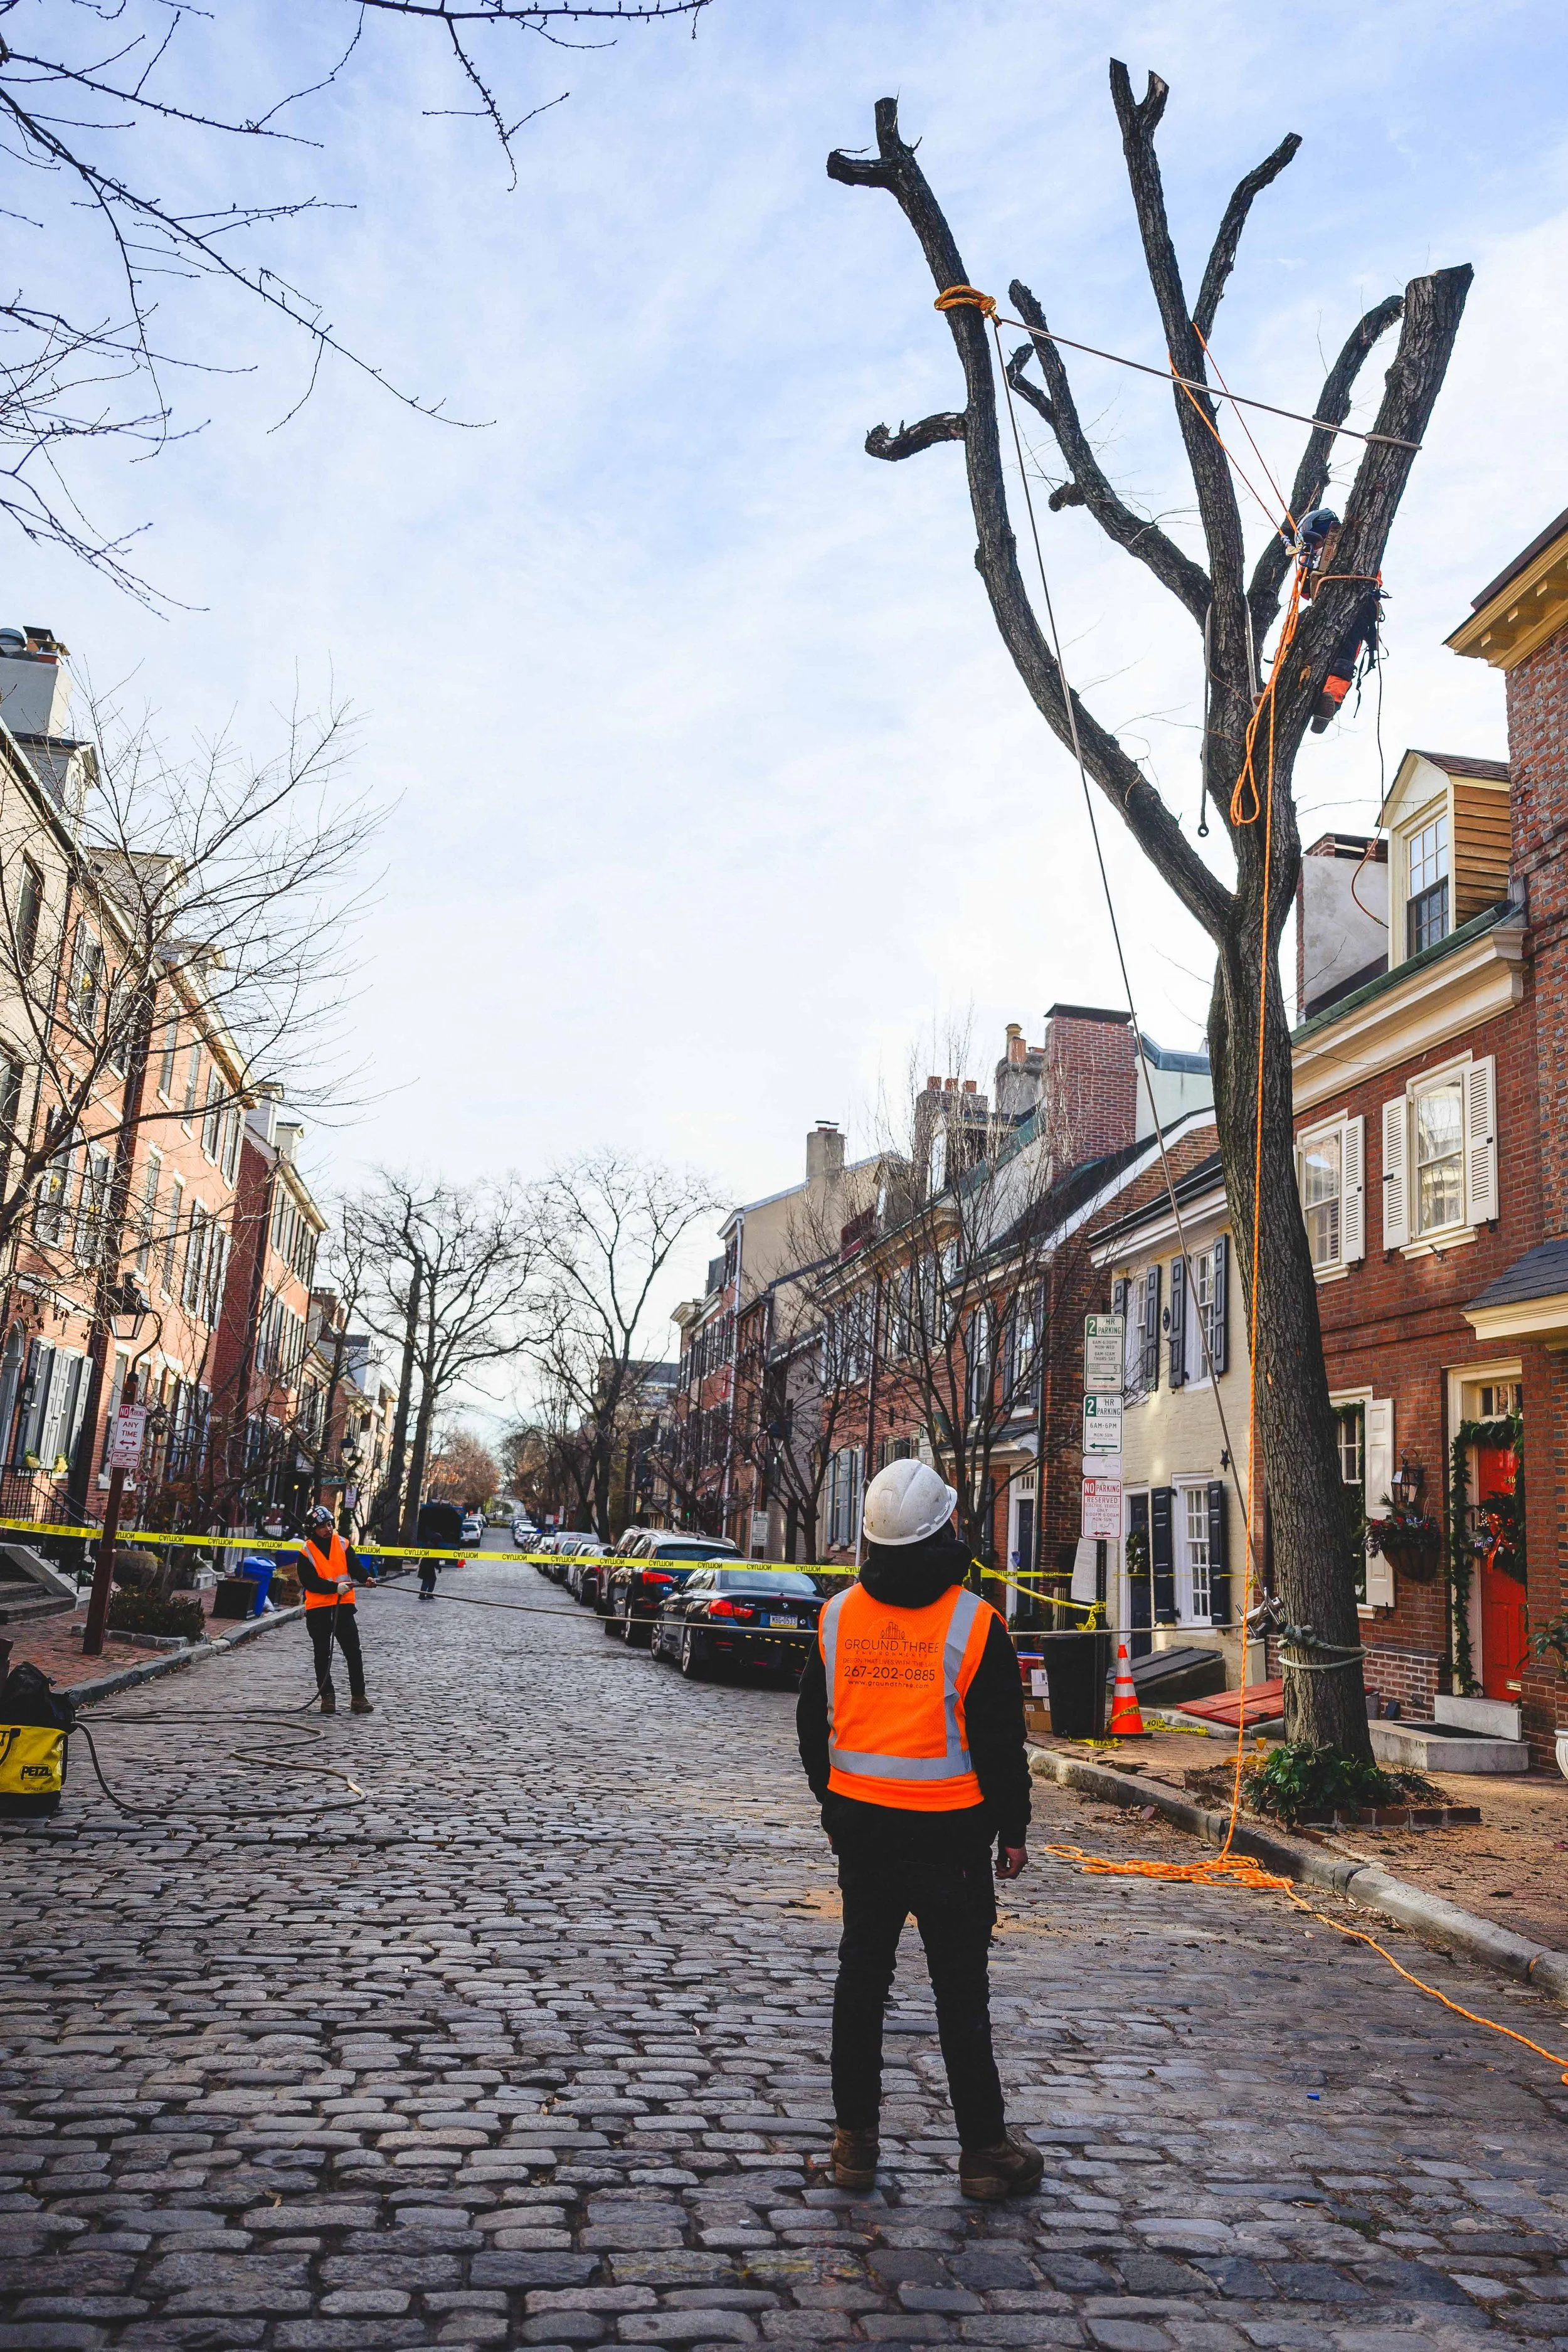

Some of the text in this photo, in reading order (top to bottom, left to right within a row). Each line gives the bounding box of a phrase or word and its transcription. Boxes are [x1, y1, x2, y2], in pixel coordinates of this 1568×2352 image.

[1089, 1320, 1095, 1334] 2
[120, 1407, 129, 1417] NO
[1088, 1399, 1094, 1414] 2
[1084, 1482, 1120, 1493] NO PARKING
[845, 1639, 940, 1653] GROUND THREE
[844, 1665, 935, 1681] 267-202-0885
[848, 1680, 929, 1688] www.groundthree.com
[21, 1766, 52, 1780] PETZL
